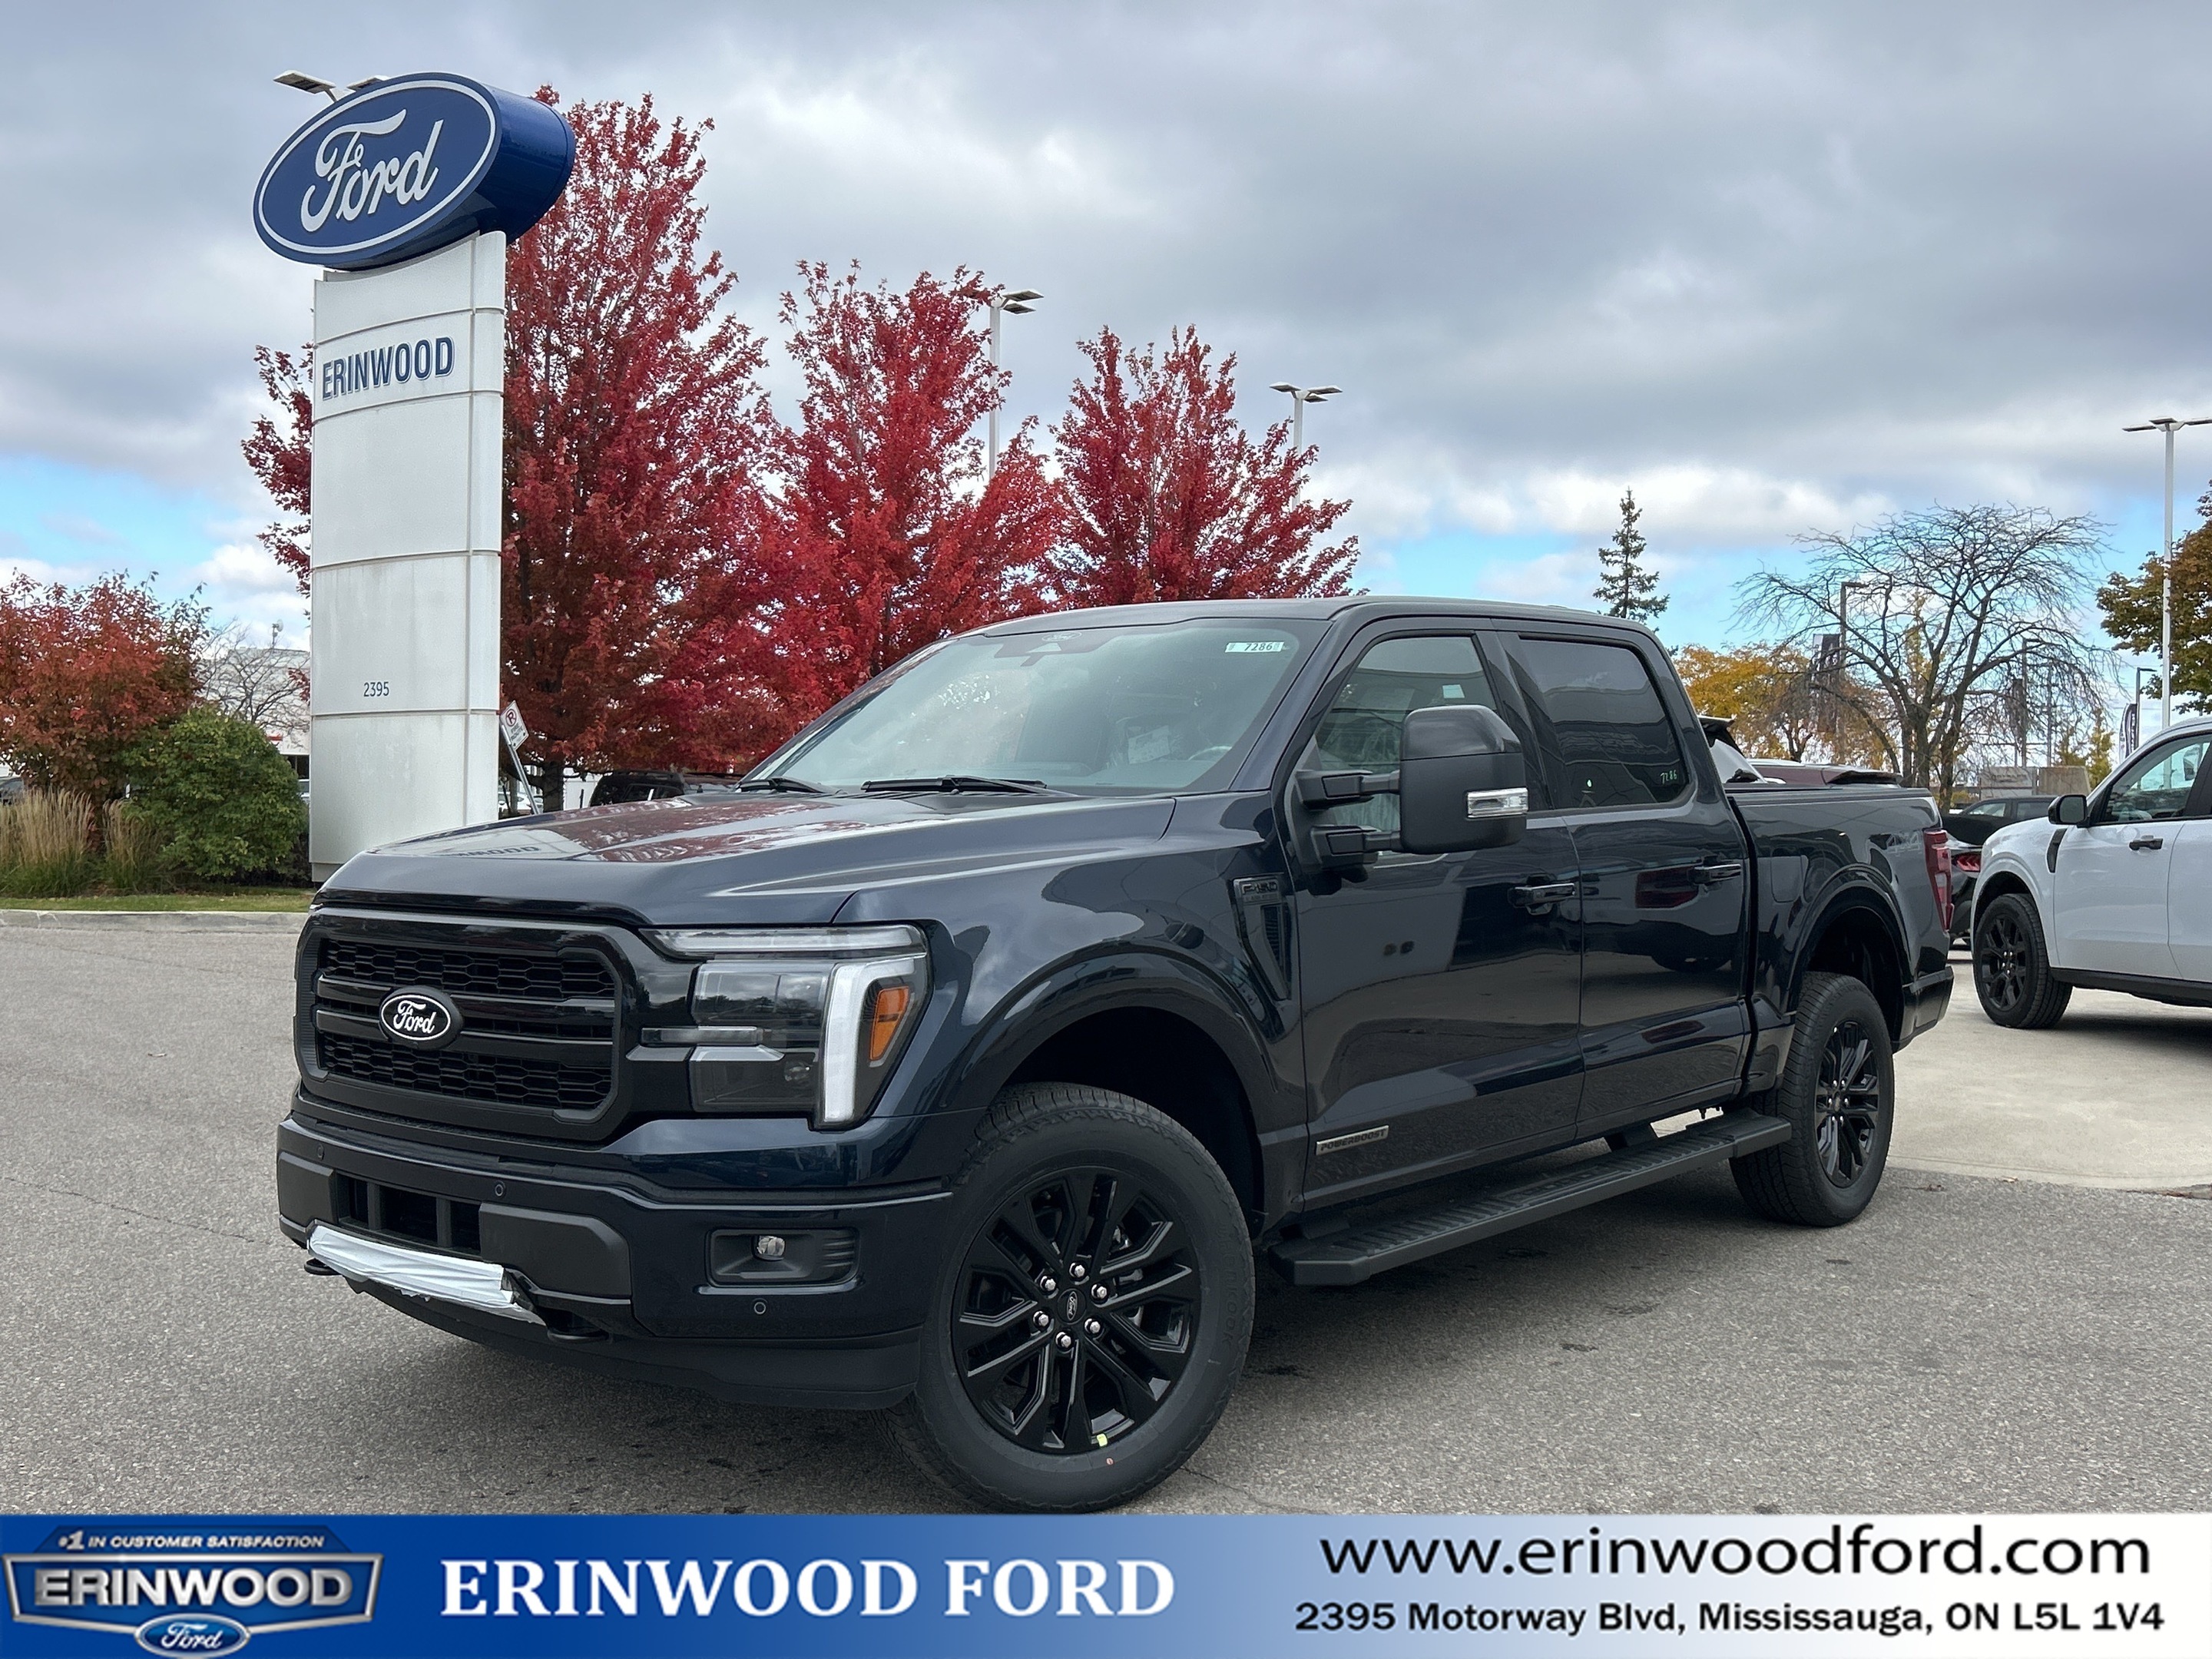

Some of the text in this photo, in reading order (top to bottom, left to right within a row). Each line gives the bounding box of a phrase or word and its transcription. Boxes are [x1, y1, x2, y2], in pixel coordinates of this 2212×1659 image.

[301, 108, 444, 232] Ford
[322, 336, 455, 401] ERINWOOD
[1243, 642, 1273, 652] 7286
[363, 681, 389, 697] 2395
[392, 999, 437, 1034] Ford
[1320, 1128, 1387, 1151] POWERBOOST
